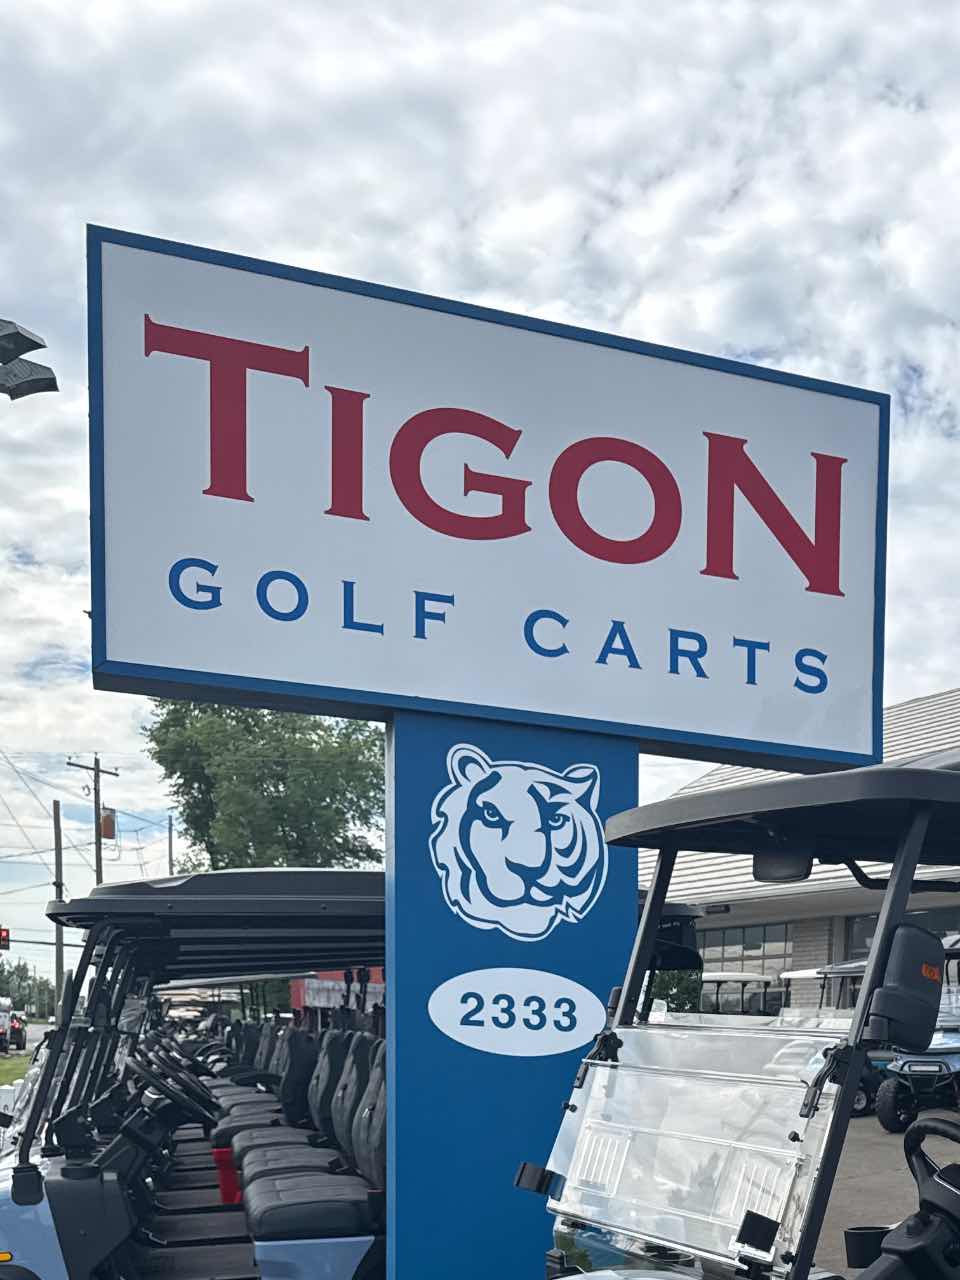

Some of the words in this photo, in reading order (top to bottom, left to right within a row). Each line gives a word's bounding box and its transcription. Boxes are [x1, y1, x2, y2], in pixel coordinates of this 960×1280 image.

[144, 313, 848, 597] TIGON
[168, 557, 456, 640] GOLF
[523, 608, 829, 694] CARTS
[459, 991, 578, 1033] 2333
